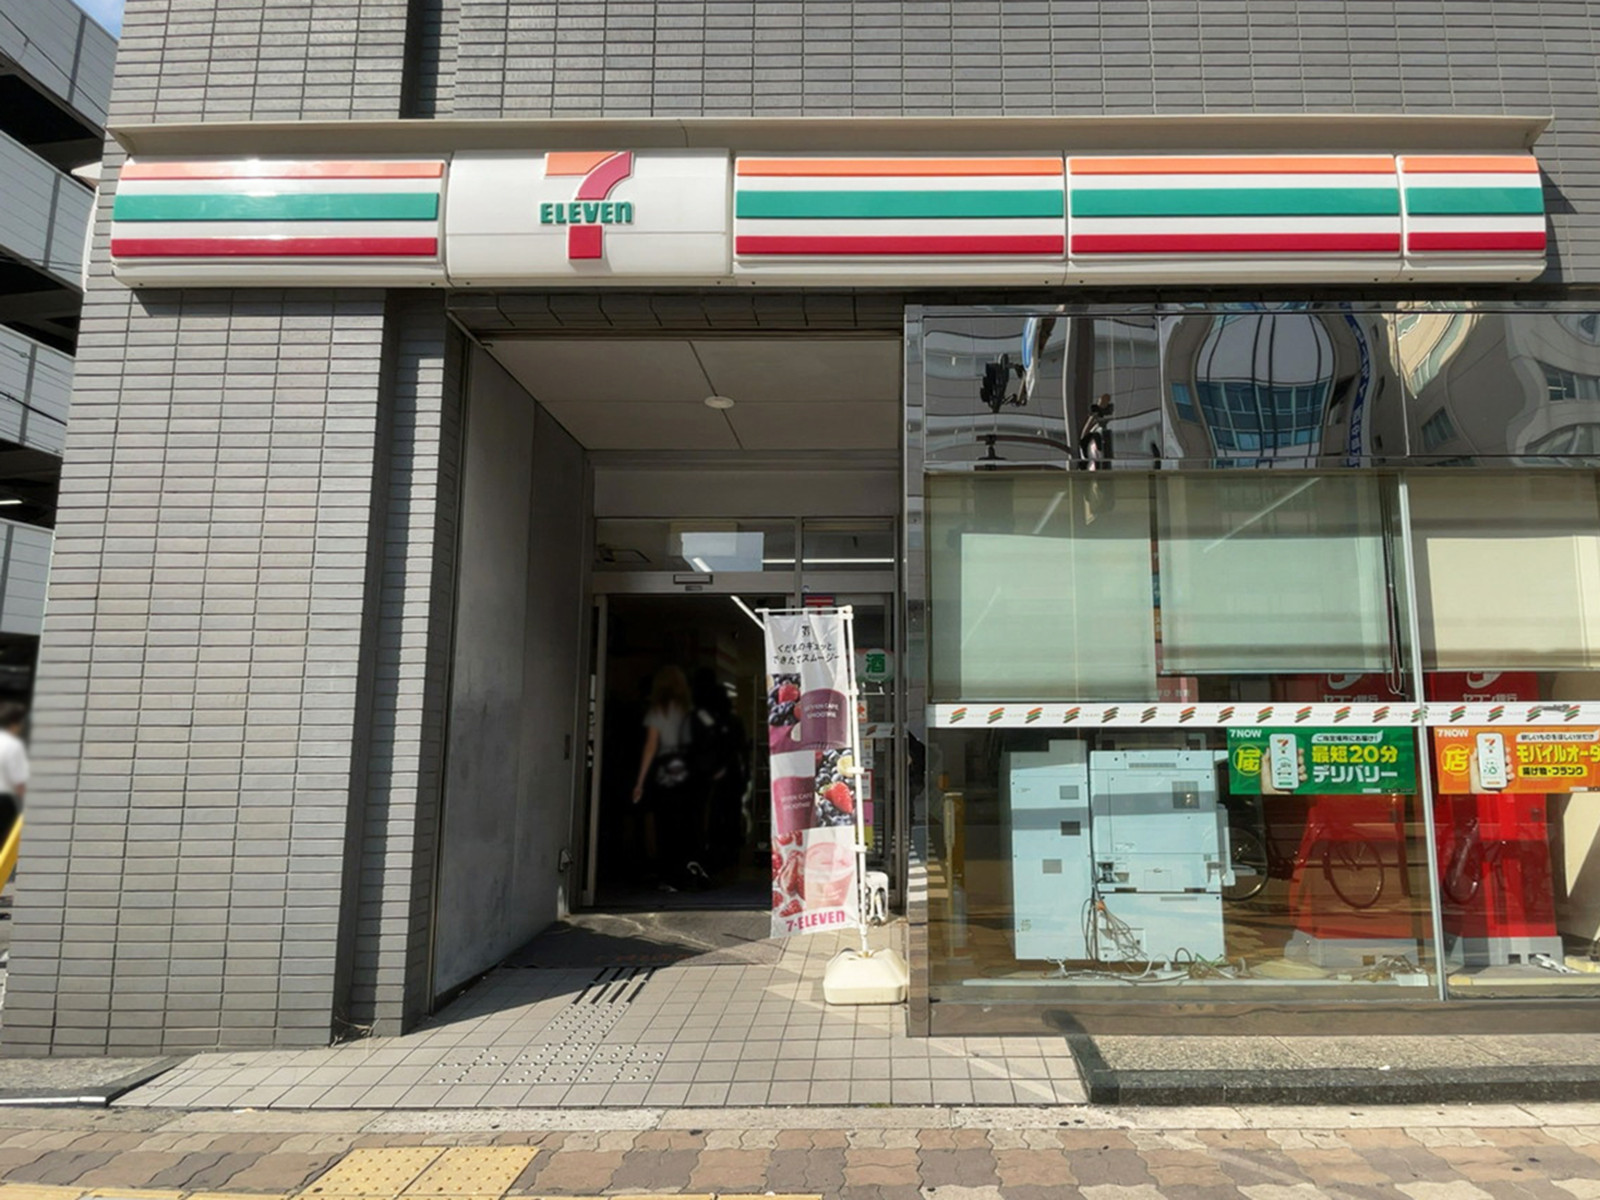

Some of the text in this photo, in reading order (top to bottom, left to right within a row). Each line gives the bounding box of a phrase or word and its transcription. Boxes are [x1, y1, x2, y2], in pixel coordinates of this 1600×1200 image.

[540, 202, 633, 224] ELEVEN
[544, 151, 633, 260] 7
[865, 653, 886, 674] 酒
[1229, 729, 1262, 738] 7NOW
[1437, 728, 1469, 738] 7NOW
[1312, 745, 1399, 763] 最短20分
[1443, 748, 1470, 771] 店
[1312, 764, 1398, 783] デリバリー
